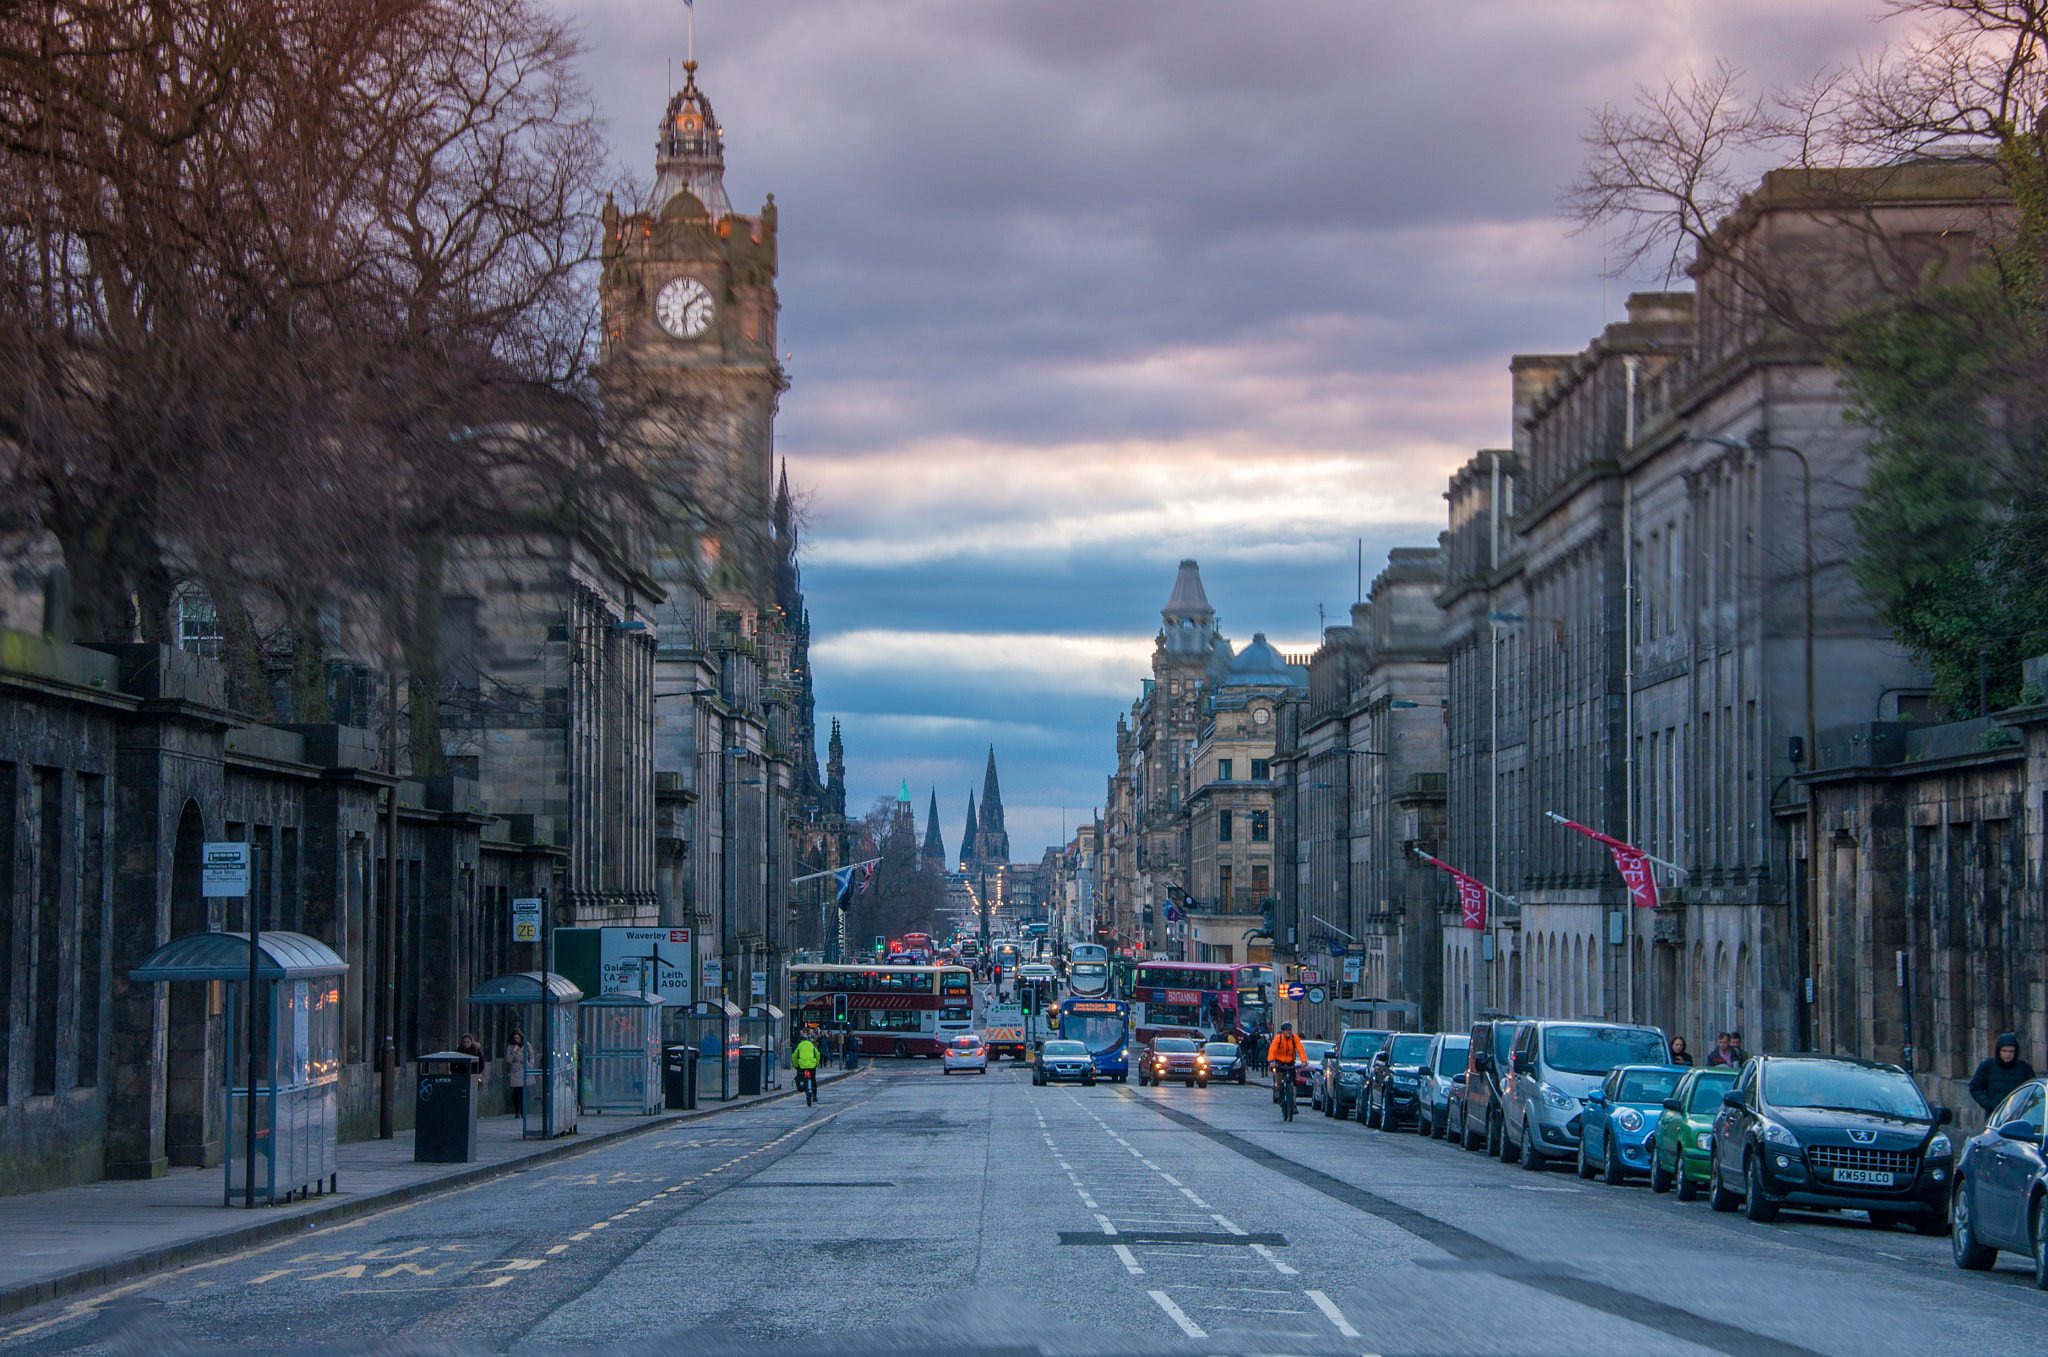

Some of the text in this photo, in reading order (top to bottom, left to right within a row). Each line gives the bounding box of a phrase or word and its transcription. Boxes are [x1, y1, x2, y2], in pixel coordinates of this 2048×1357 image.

[1622, 852, 1647, 899] PEX
[519, 925, 534, 937] ZE
[626, 931, 666, 940] Waverley
[661, 971, 683, 979] Leith
[661, 980, 688, 988] A900
[1168, 991, 1199, 1004] BRITANNIA
[1222, 994, 1230, 1003] 22
[1106, 1003, 1116, 1012] 38
[1838, 1169, 1867, 1181] KW59
